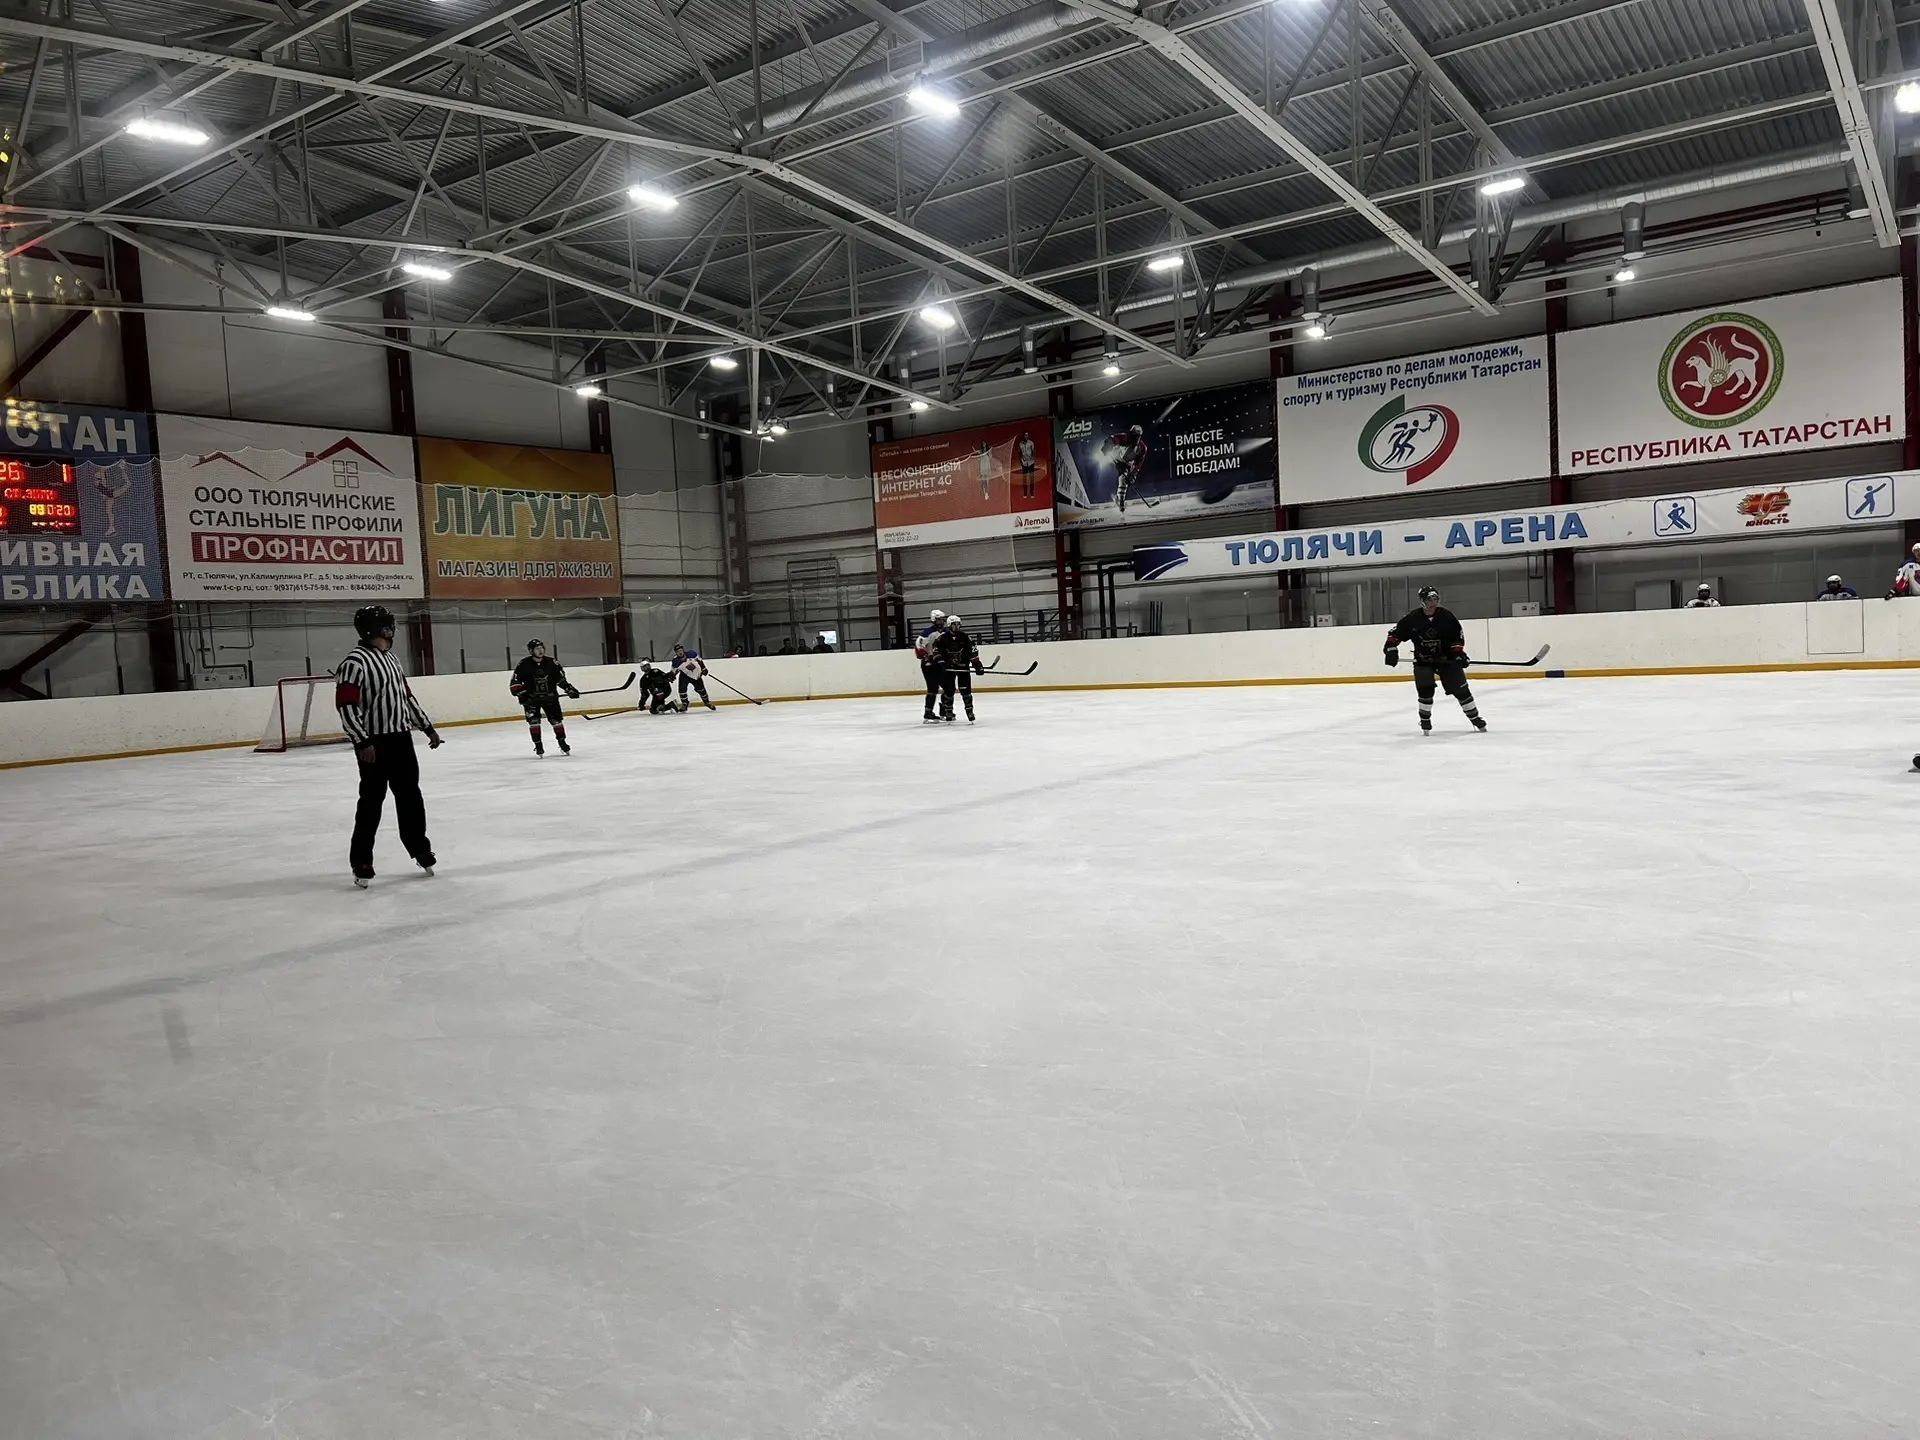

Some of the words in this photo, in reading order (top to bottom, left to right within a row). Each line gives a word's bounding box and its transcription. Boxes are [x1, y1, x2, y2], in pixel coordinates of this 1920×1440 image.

[1297, 367, 1383, 389] Министерство
[1386, 364, 1401, 376] по
[1404, 357, 1445, 375] делам
[1449, 345, 1523, 364] молодежи,
[1283, 391, 1323, 407] спорту
[1325, 390, 1333, 401] и
[1336, 381, 1387, 402] туризму
[1390, 369, 1467, 390] Республики
[1471, 358, 1541, 378] Татарстан
[5, 413, 137, 453] СТАН
[1175, 429, 1224, 446] ВМЕСТЕ
[1571, 433, 1731, 468] РЕСПУБЛИКА
[1738, 414, 1892, 449] ТАТАРСТАН
[1176, 450, 1184, 461] К
[1186, 442, 1235, 460] НОВЫМ
[881, 460, 961, 481] БЕСКОНЕЧНЫЙ
[1176, 457, 1241, 476] ПОБЕДАМ!
[882, 477, 936, 494] ИНТЕРНЕТ
[937, 475, 952, 487] 4G
[194, 486, 243, 504] ООО
[248, 489, 395, 511] ТЮЛЯЧИНСКИЕ
[189, 509, 306, 529] СТАЛЬНЫЕ
[312, 515, 403, 532] ПРОФИЛИ
[433, 484, 611, 541] ЛИГУНА
[1023, 517, 1050, 526] Летай
[1745, 518, 1790, 527] ЮНОСТЬ
[201, 535, 398, 562] ПРОФНАСТИЛ
[1225, 530, 1383, 566] ТЮЛЯЧИ
[1445, 512, 1588, 549] АРЕНА
[0, 541, 146, 566] ИВНАЯ
[438, 560, 519, 578] МАГАЗИН
[523, 561, 556, 580] ДЛЯ
[560, 562, 613, 579] ЖИЗНИ
[2, 575, 150, 600] БЛИКА
